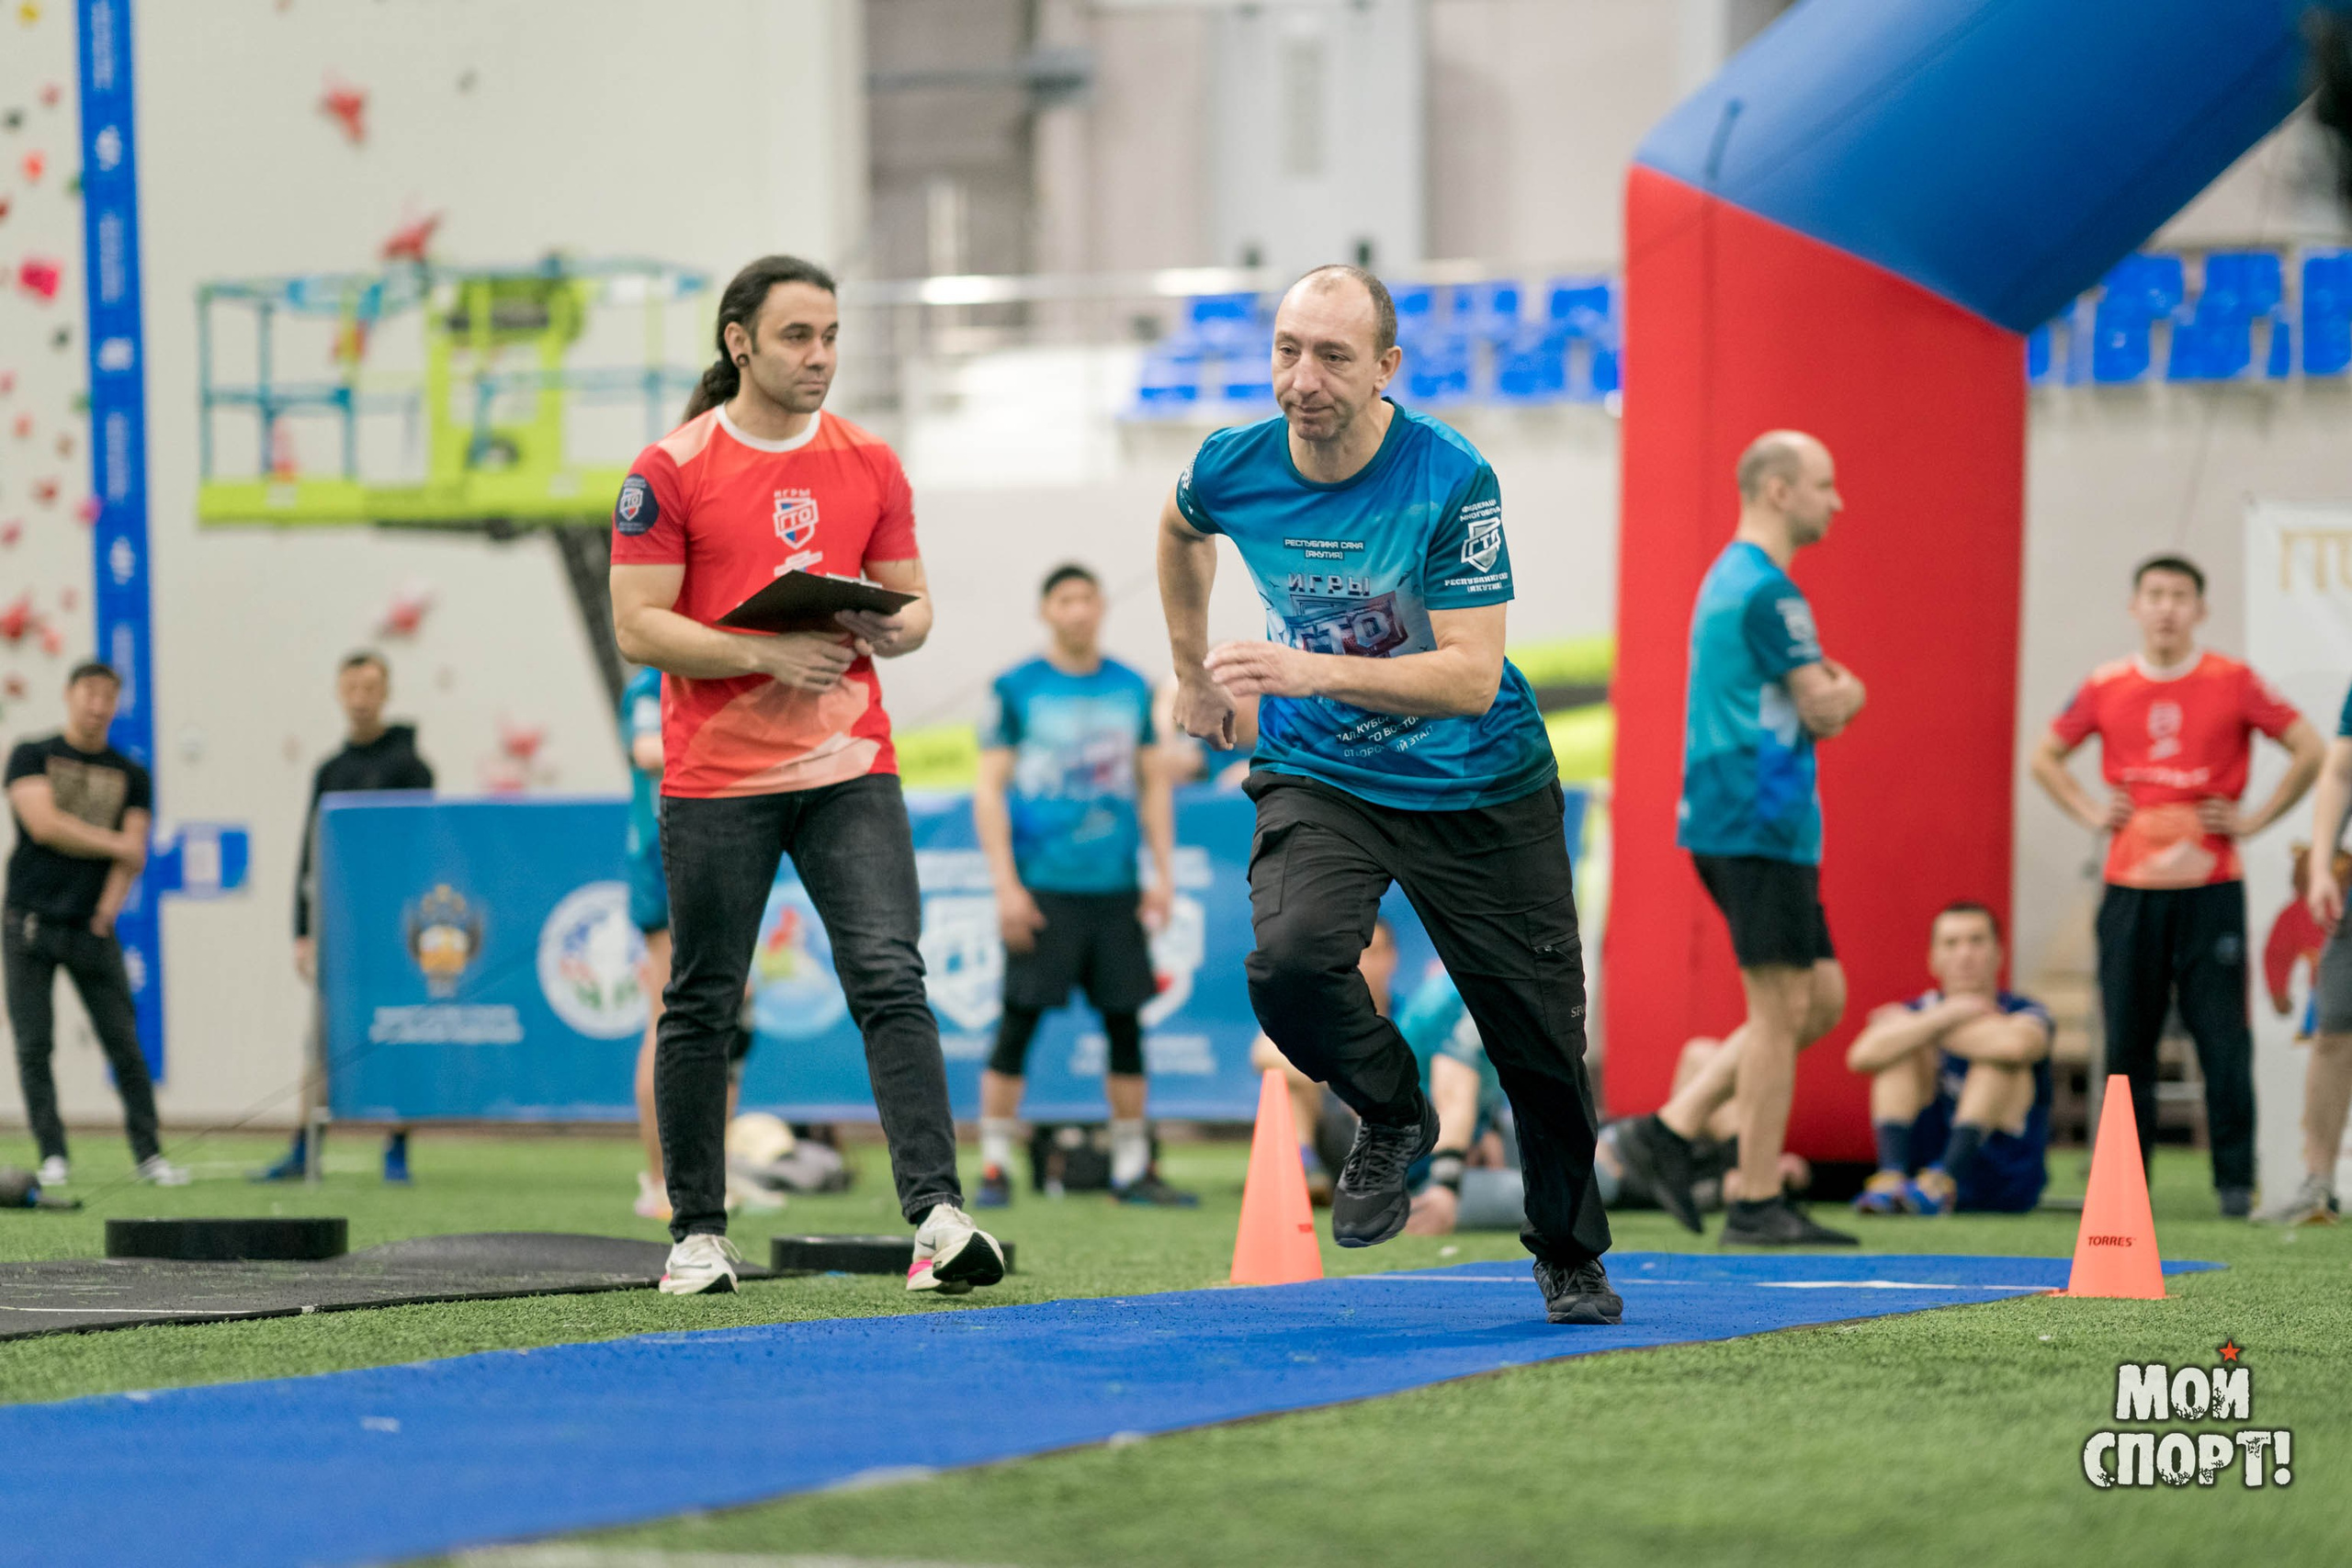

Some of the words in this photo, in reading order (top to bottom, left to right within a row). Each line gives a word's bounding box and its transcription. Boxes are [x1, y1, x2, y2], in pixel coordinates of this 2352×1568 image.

[781, 507, 812, 532] ГТО
[1284, 538, 1340, 549] РЕСПУБЛИКА
[1340, 541, 1364, 550] САХА
[2279, 526, 2352, 593] ГТ
[1288, 572, 1371, 597] ИГРЫ
[2087, 1235, 2132, 1247] TORRES
